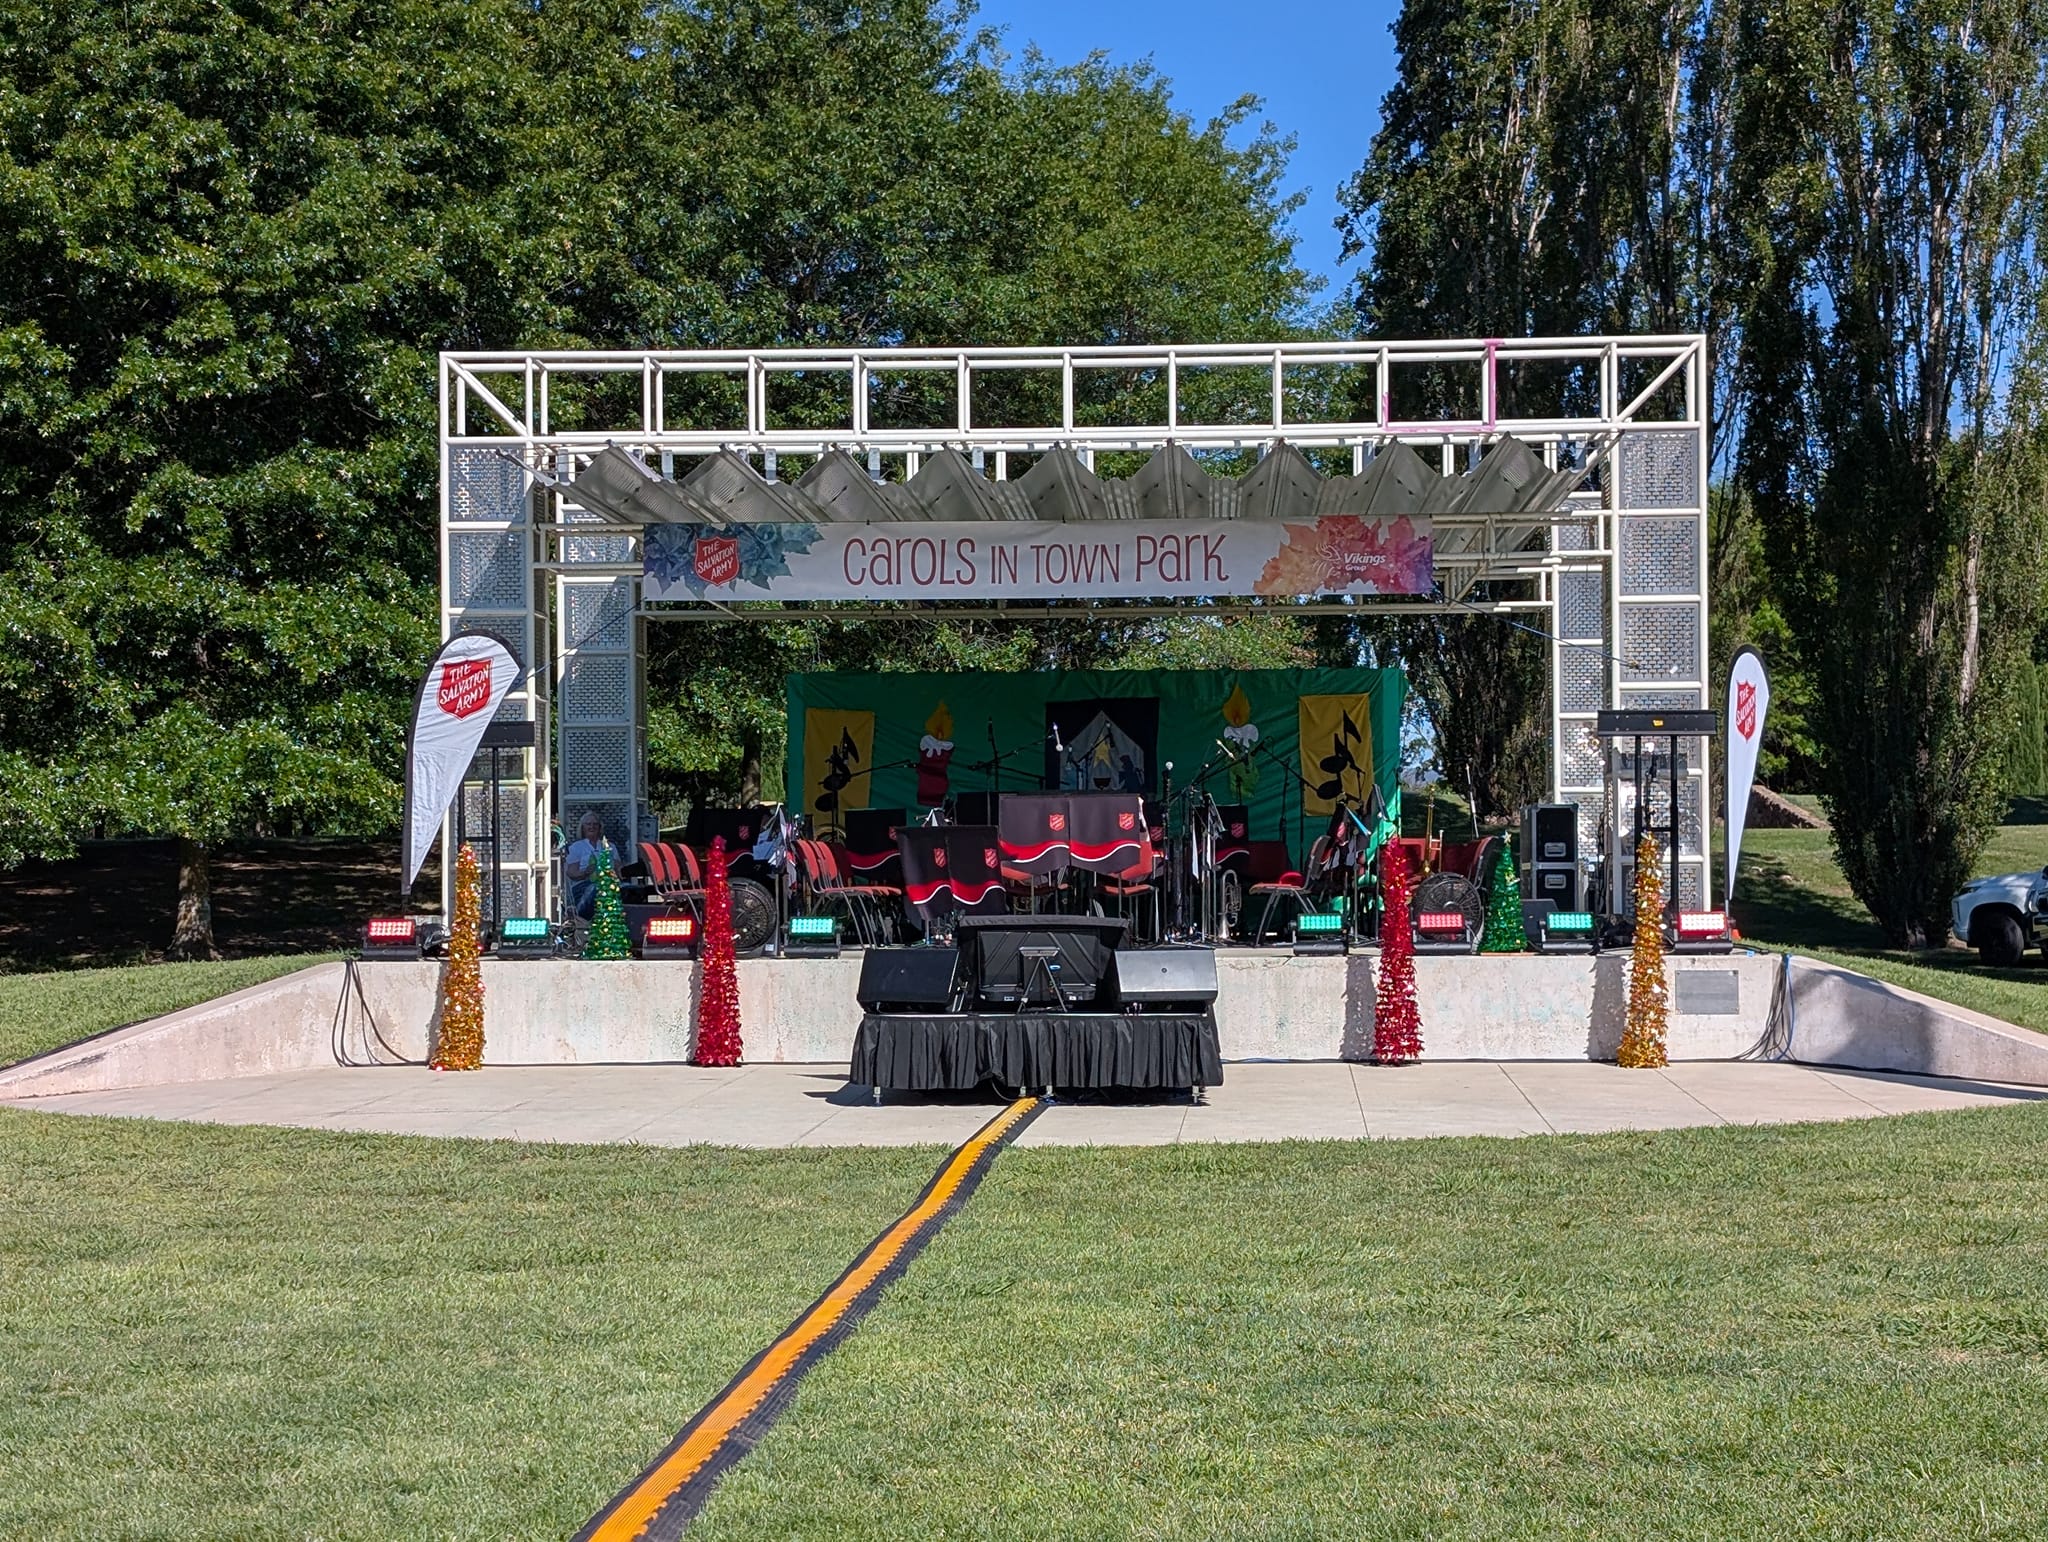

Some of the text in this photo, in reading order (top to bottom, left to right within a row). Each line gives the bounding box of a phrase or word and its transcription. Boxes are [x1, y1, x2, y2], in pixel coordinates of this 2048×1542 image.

[697, 543, 735, 574] SALVATION
[702, 541, 720, 556] THE
[1343, 552, 1387, 566] Vikings
[711, 556, 734, 580] ARMY
[990, 544, 1018, 585] IN
[1030, 543, 1121, 584] TOWN
[1345, 563, 1367, 572] Group
[439, 664, 490, 705] SALVATION
[449, 664, 472, 683] THE
[454, 682, 487, 714] ARMY
